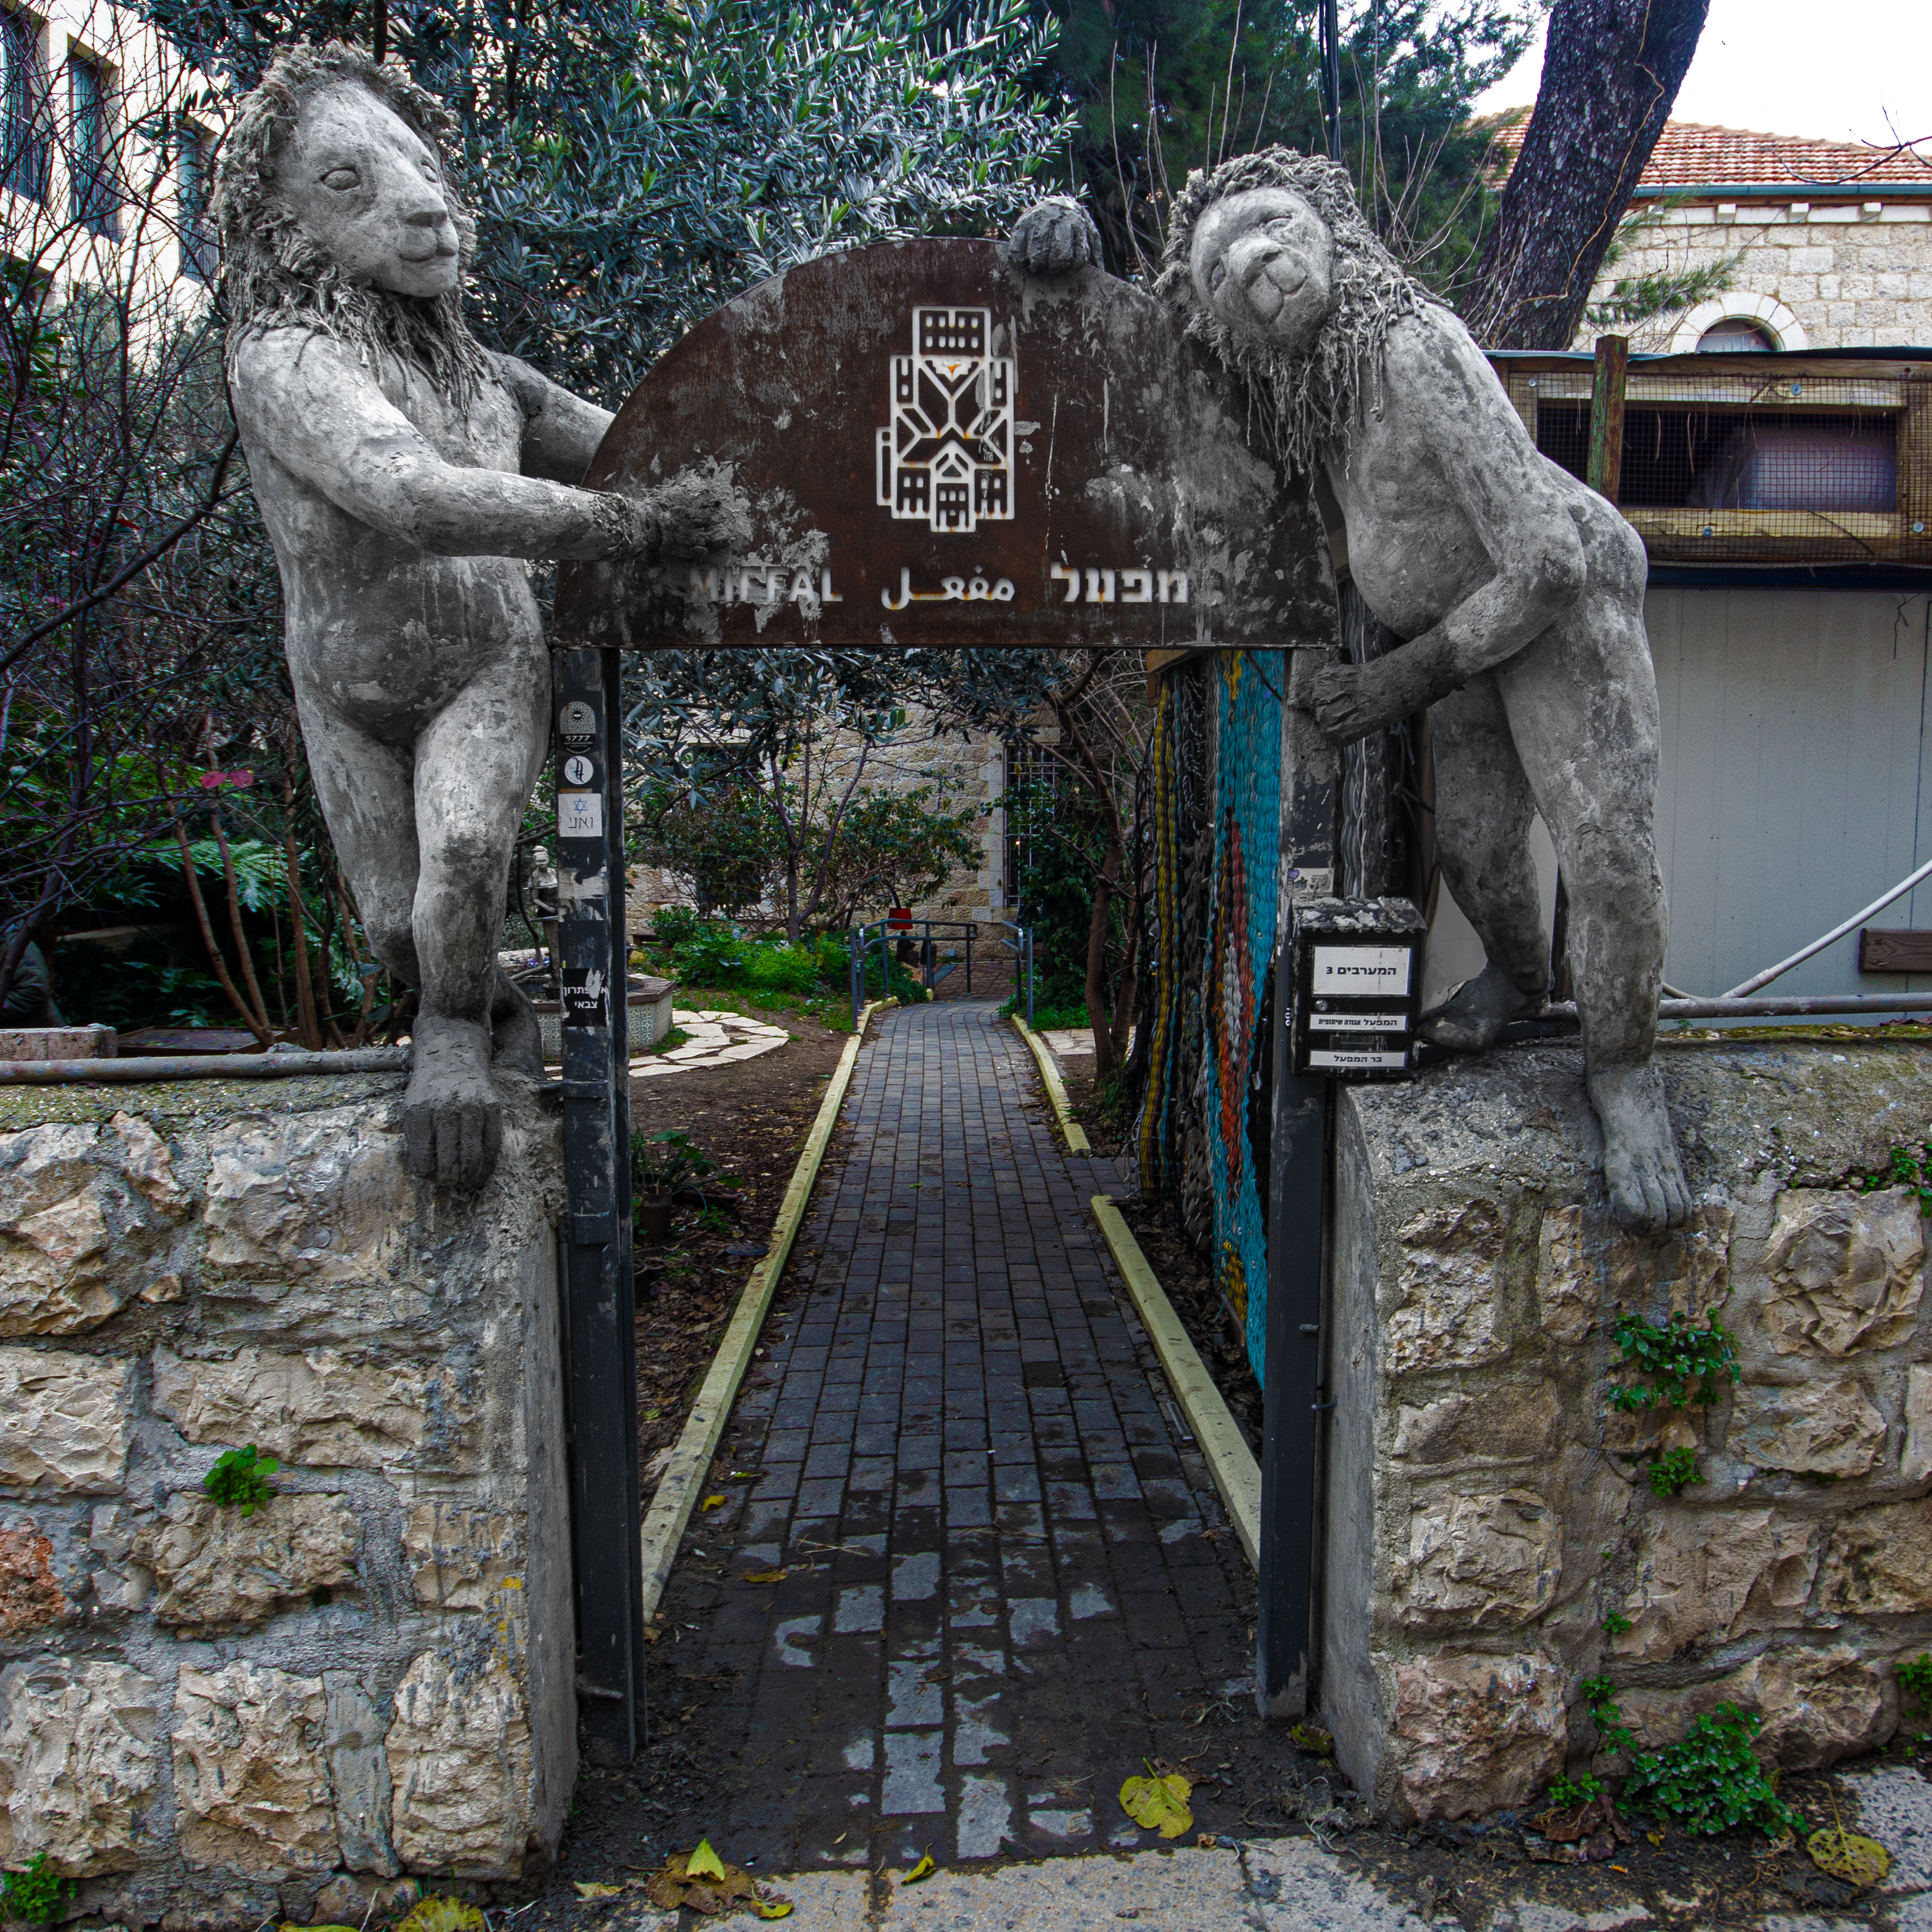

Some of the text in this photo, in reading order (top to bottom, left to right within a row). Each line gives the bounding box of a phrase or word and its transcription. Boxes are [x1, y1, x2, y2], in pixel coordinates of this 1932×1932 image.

[689, 566, 842, 601] MIFFAL
[881, 564, 1015, 610] مفعل
[1051, 562, 1188, 602] מפעל
[568, 817, 594, 829] ואני
[1326, 966, 1396, 975] המערבים 3
